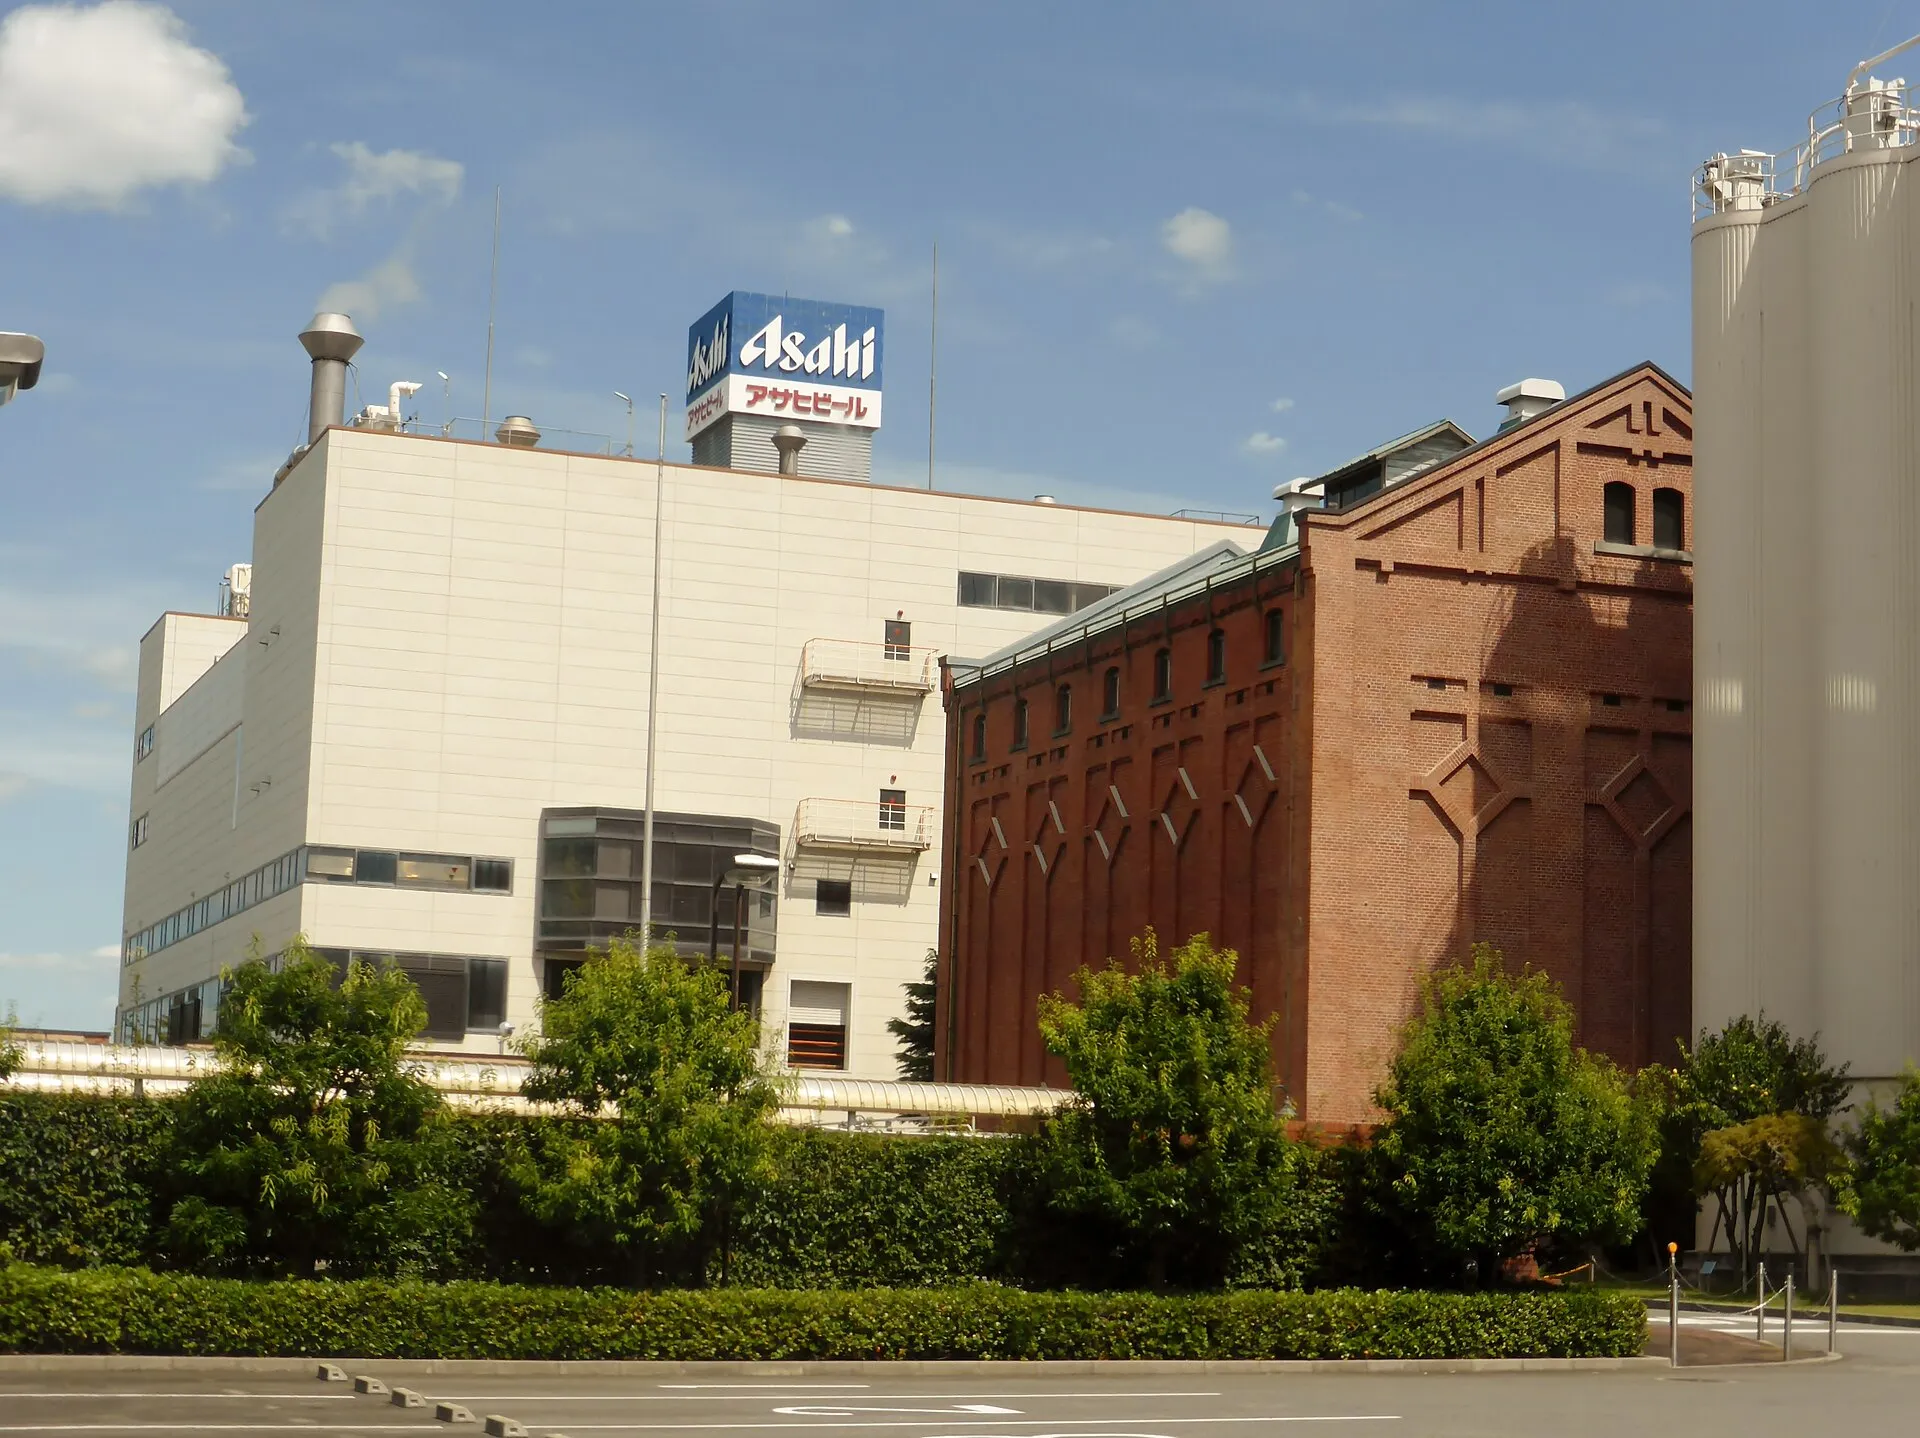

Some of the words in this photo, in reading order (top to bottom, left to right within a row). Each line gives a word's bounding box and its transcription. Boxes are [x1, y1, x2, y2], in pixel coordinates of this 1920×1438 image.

[688, 312, 729, 395] Asahi
[740, 314, 875, 380] Asahi
[688, 388, 724, 431] アサヒビール
[746, 384, 868, 418] アサヒビール
